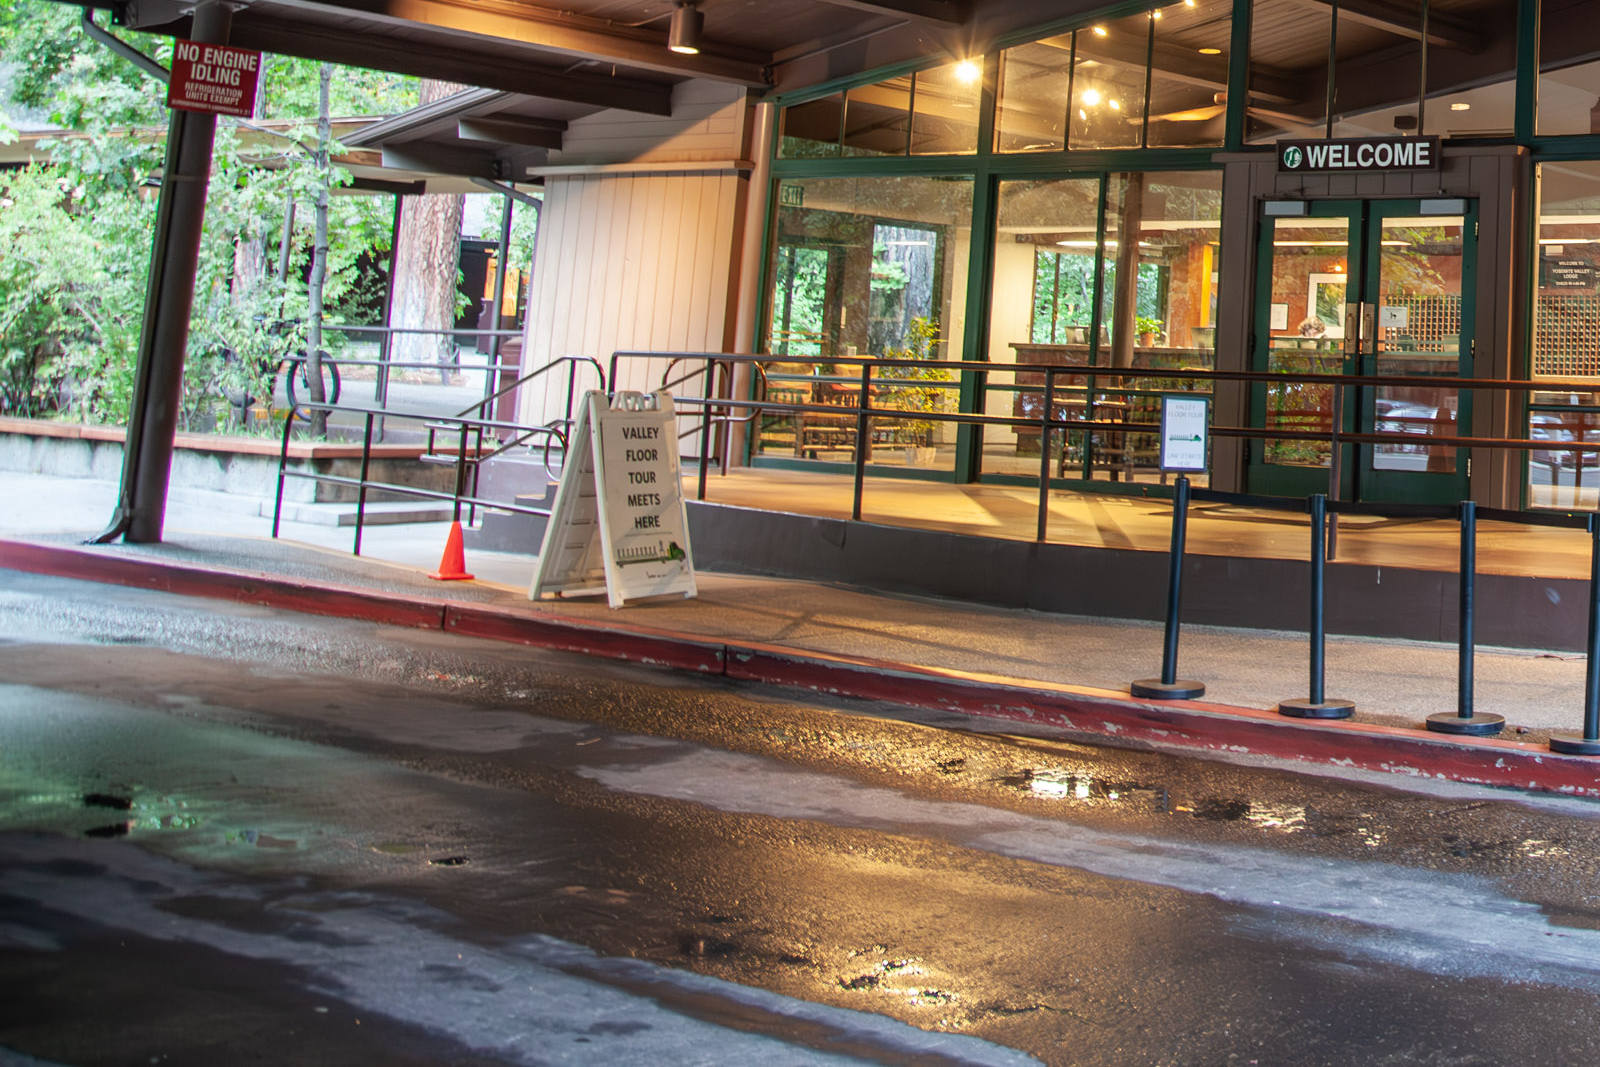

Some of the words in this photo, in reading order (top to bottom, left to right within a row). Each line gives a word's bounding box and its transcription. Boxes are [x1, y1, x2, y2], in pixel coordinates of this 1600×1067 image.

[177, 43, 200, 62] NO
[204, 47, 258, 72] ENGINE
[190, 63, 240, 87] IDLING
[185, 81, 243, 99] REFRIGERATION
[185, 91, 208, 102] UNITS
[210, 94, 239, 106] EXEMPT
[1306, 142, 1430, 168] WELCOME
[622, 427, 659, 440] VALLEY
[626, 449, 658, 462] FLOOR
[628, 471, 656, 484] TOUR
[627, 493, 661, 507] MEETS
[634, 515, 661, 529] HERE
